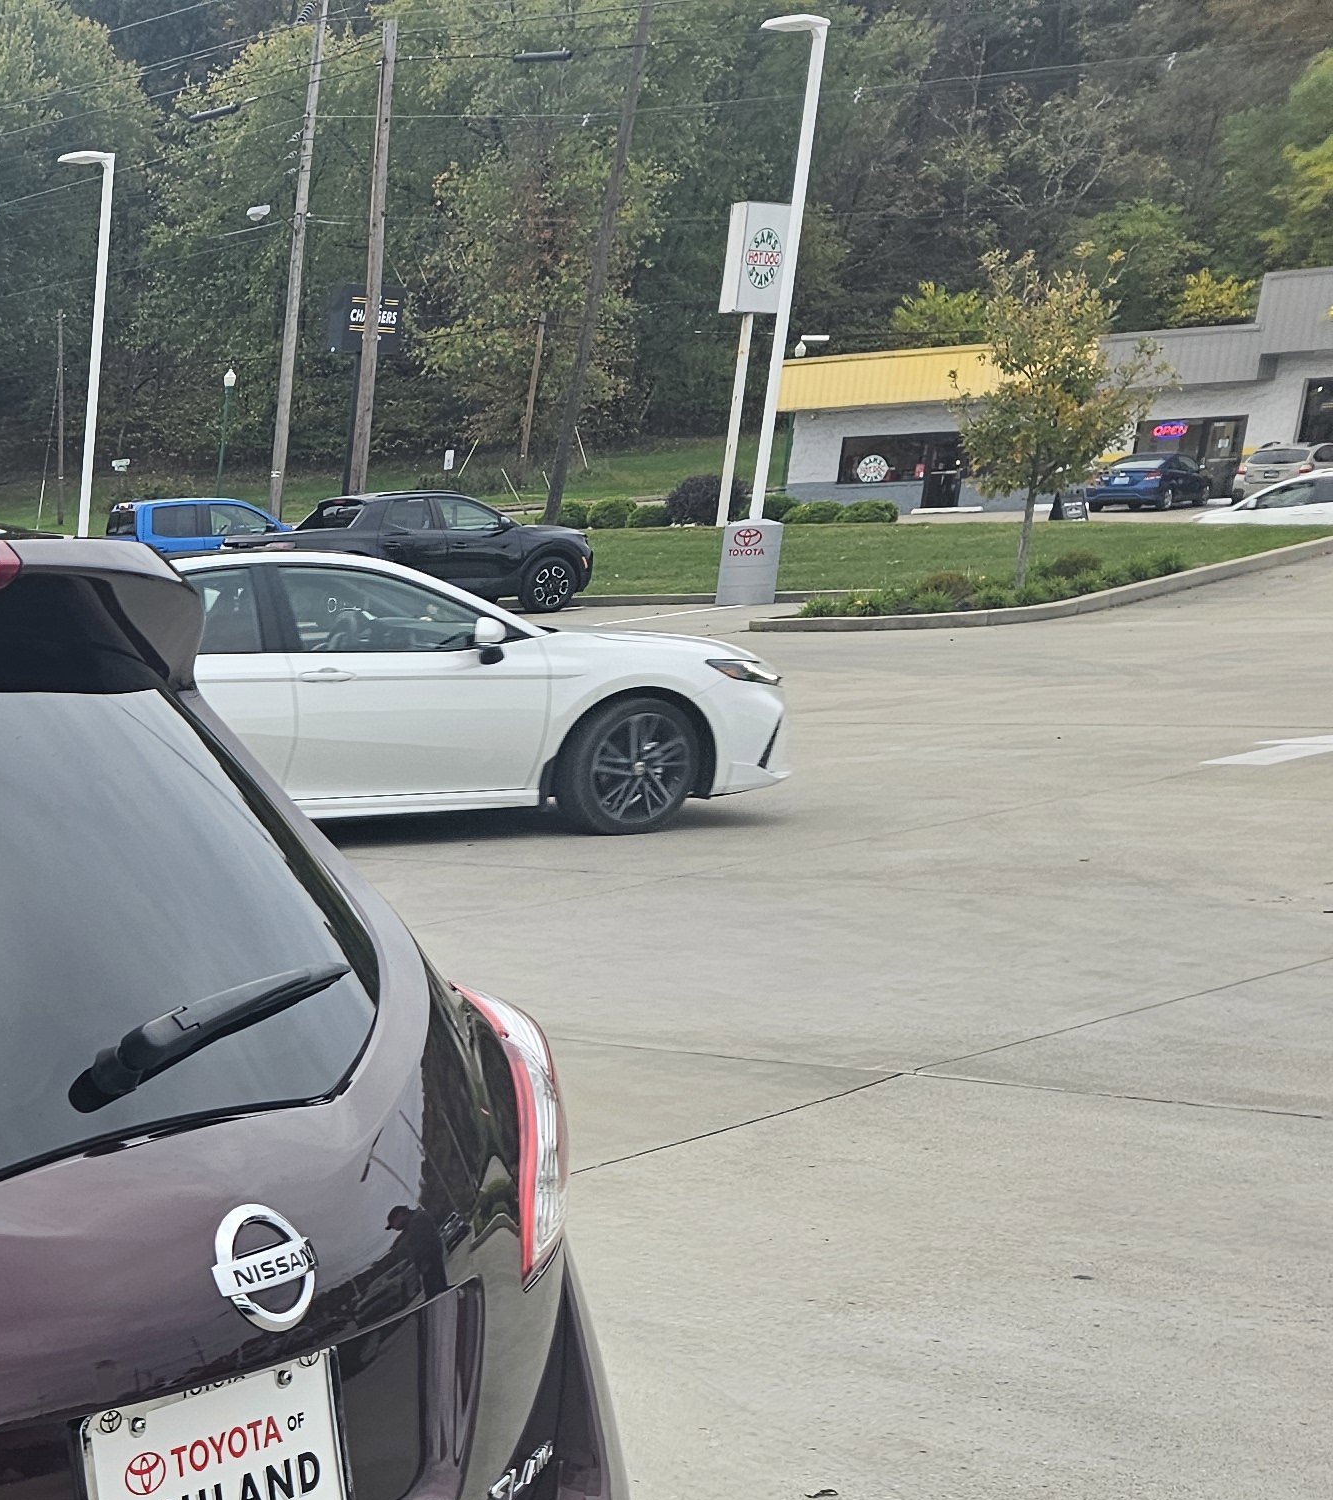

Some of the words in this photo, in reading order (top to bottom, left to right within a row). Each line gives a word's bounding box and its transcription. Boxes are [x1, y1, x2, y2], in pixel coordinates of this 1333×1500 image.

[754, 231, 779, 250] SAM'S
[748, 252, 763, 264] HOT
[764, 253, 780, 265] DOG
[749, 266, 775, 287] STAND
[1152, 424, 1188, 437] OPEN
[728, 548, 765, 557] TOYOTA
[233, 1245, 316, 1288] NISSAN
[170, 1415, 283, 1479] TOYOTA
[286, 1411, 306, 1433] OF
